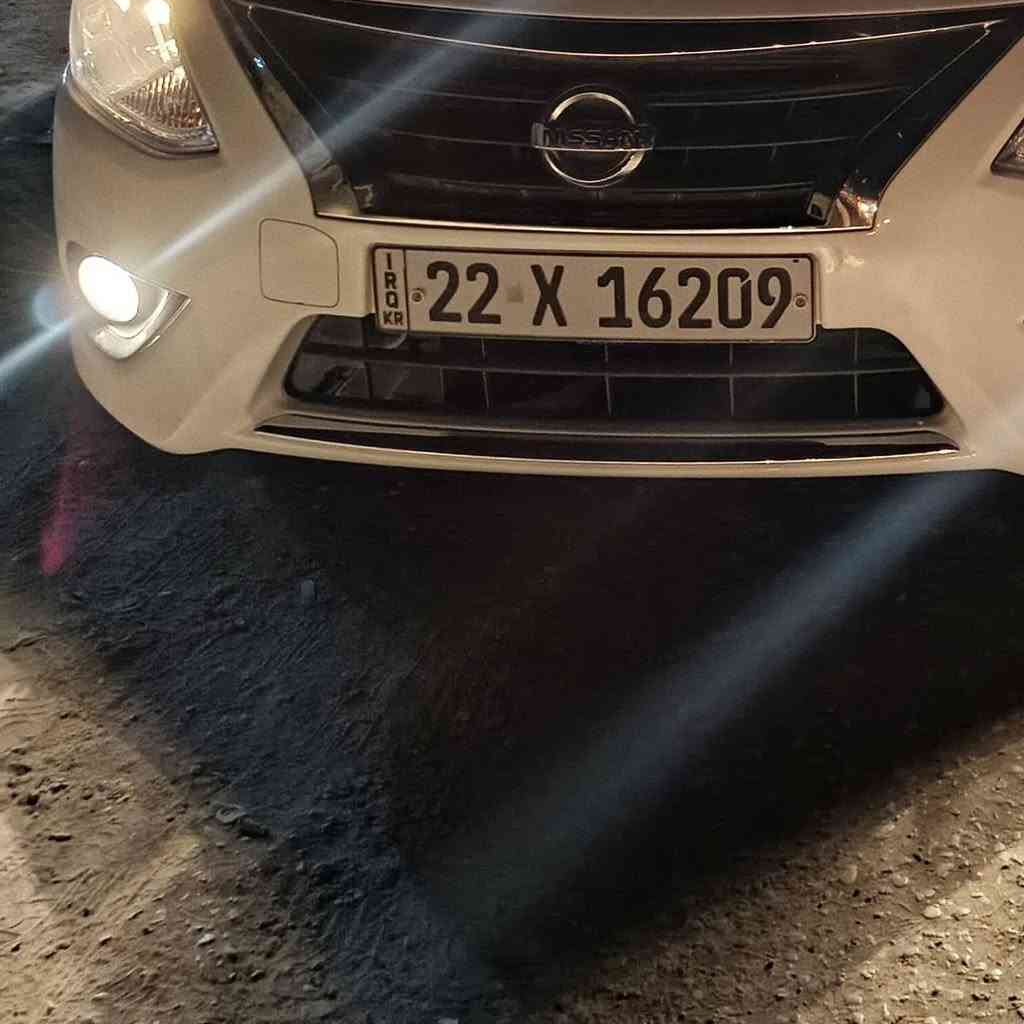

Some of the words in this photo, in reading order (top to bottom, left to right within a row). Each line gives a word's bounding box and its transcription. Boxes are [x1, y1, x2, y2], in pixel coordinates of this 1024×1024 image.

[543, 128, 640, 146] NISSAN
[426, 260, 501, 325] 22
[530, 264, 567, 327] X
[597, 266, 793, 330] 162209
[383, 312, 403, 326] KR
